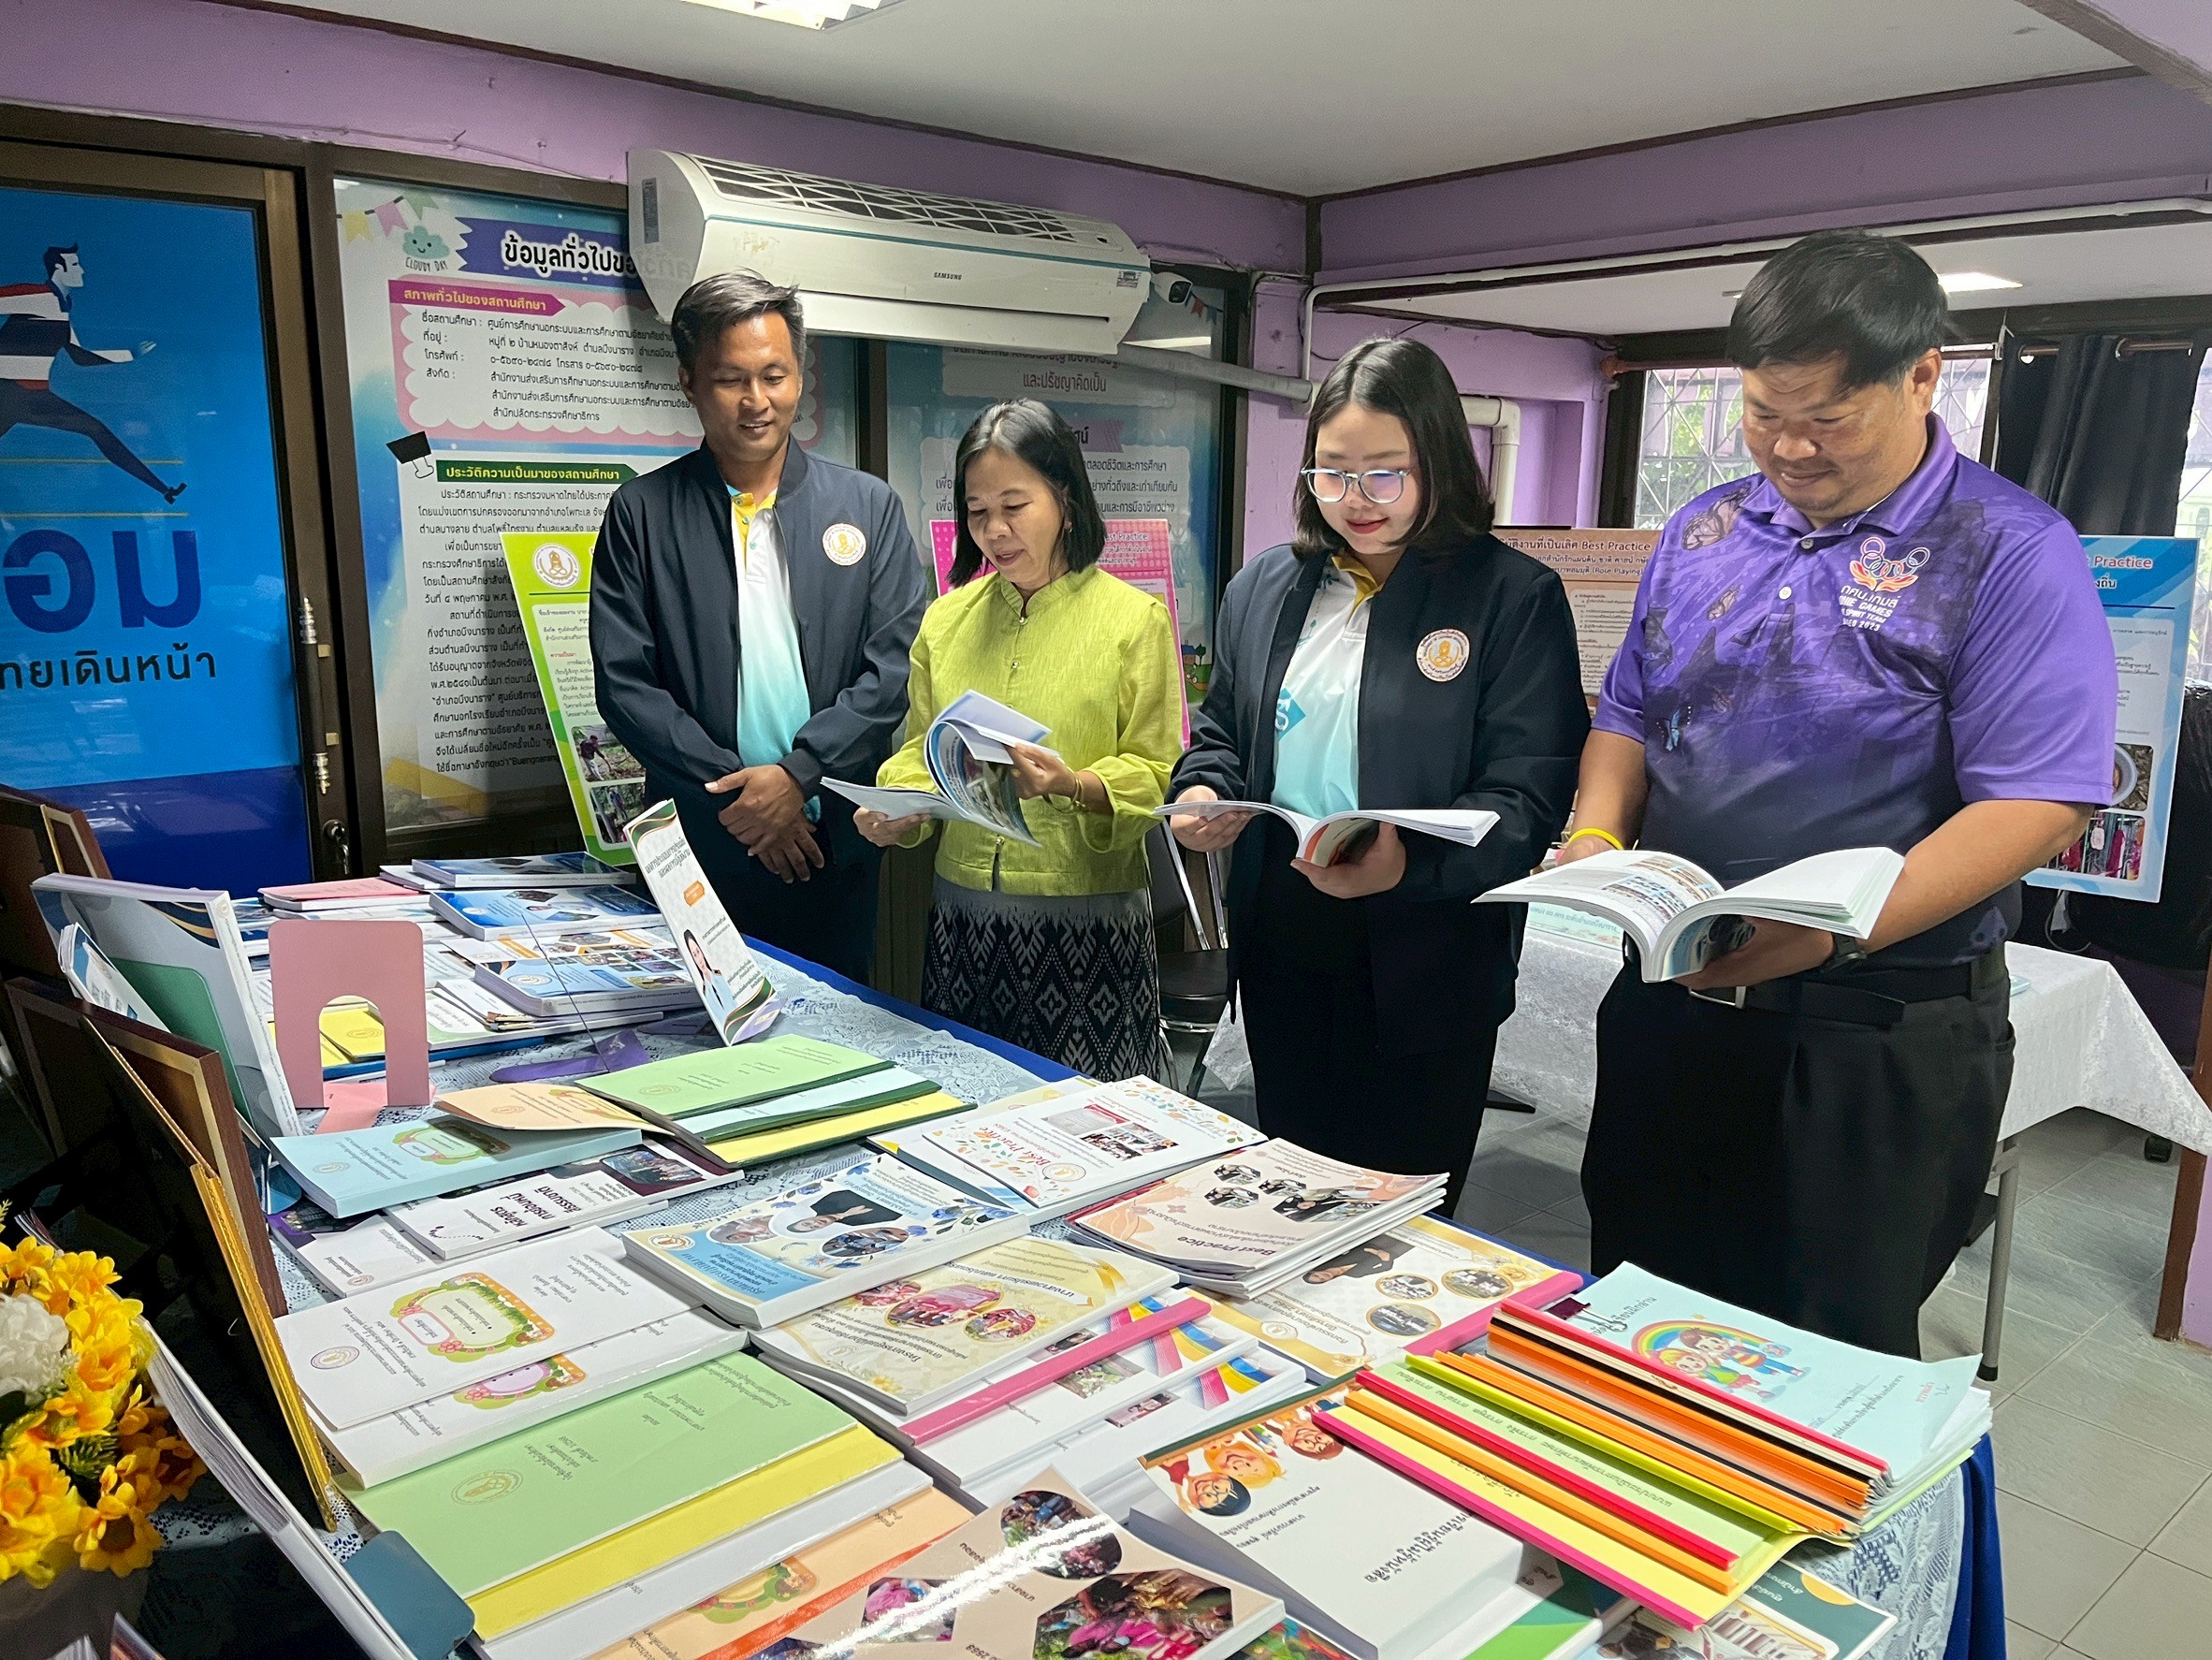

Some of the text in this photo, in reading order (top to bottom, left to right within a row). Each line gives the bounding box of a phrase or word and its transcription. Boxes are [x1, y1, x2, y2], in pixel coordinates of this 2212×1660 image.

[405, 256, 448, 272] CLOUDY DAY
[934, 271, 962, 281] SAMSUNG
[404, 287, 546, 311] สภาพทั่วไปของสถานศึกษา
[446, 466, 619, 480] ประวัติความเป็นมาของสถานศึกษา
[1581, 541, 1604, 550] Best
[1608, 541, 1651, 551] Practice
[2094, 556, 2152, 568] Practice
[1858, 602, 1893, 618] GAMES
[1858, 620, 1881, 632] 2023
[979, 1126, 1050, 1167] Best Practice
[501, 1192, 556, 1221] การย้อมหมี่
[534, 1186, 582, 1213] สีธรรมชาติ
[489, 1206, 528, 1228] หลักสูตร
[1177, 1236, 1276, 1257] Best Practice
[1397, 1372, 1433, 1391] การเขียน
[1435, 1391, 1467, 1408] การอ่าน
[966, 1645, 990, 1659] 2568
